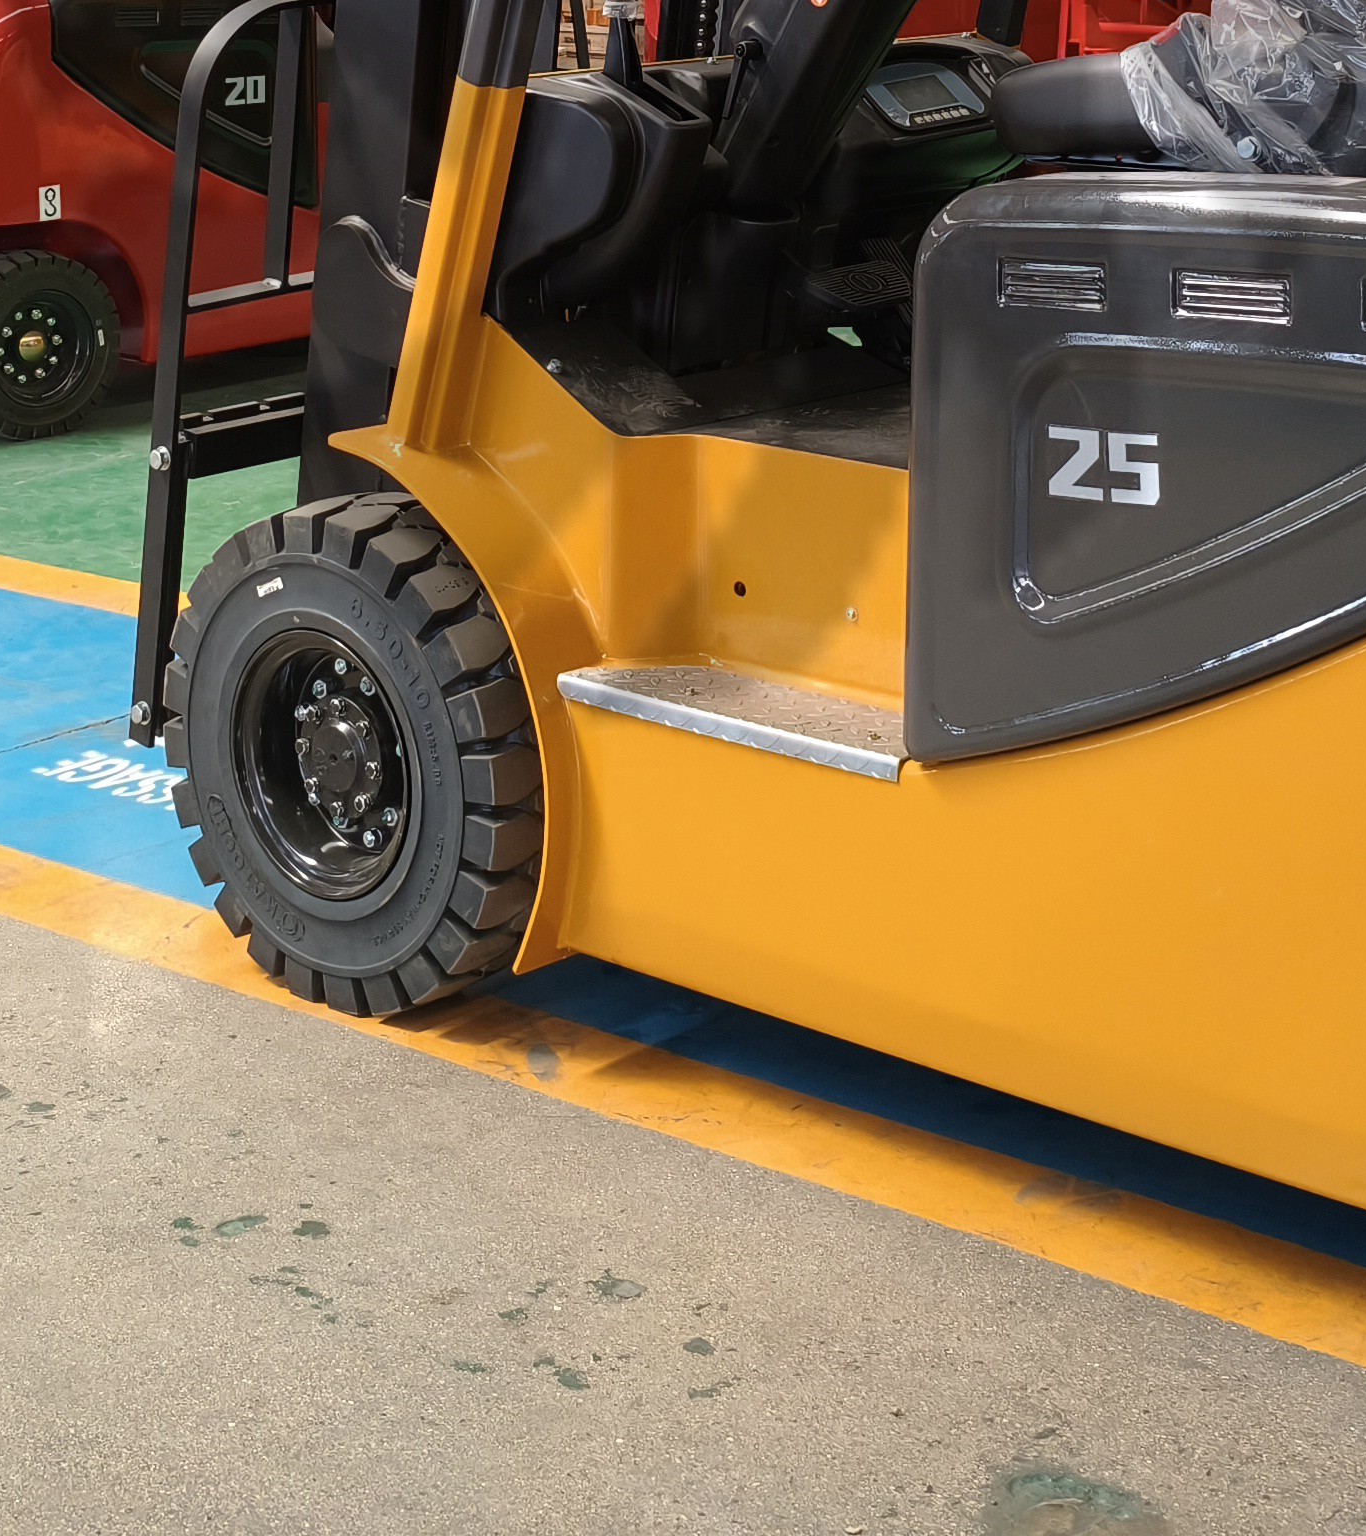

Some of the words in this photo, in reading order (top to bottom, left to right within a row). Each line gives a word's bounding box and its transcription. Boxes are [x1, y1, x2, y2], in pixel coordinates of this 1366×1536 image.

[225, 75, 266, 106] 20
[1048, 425, 1160, 506] 25
[31, 750, 188, 812] SSAGE
